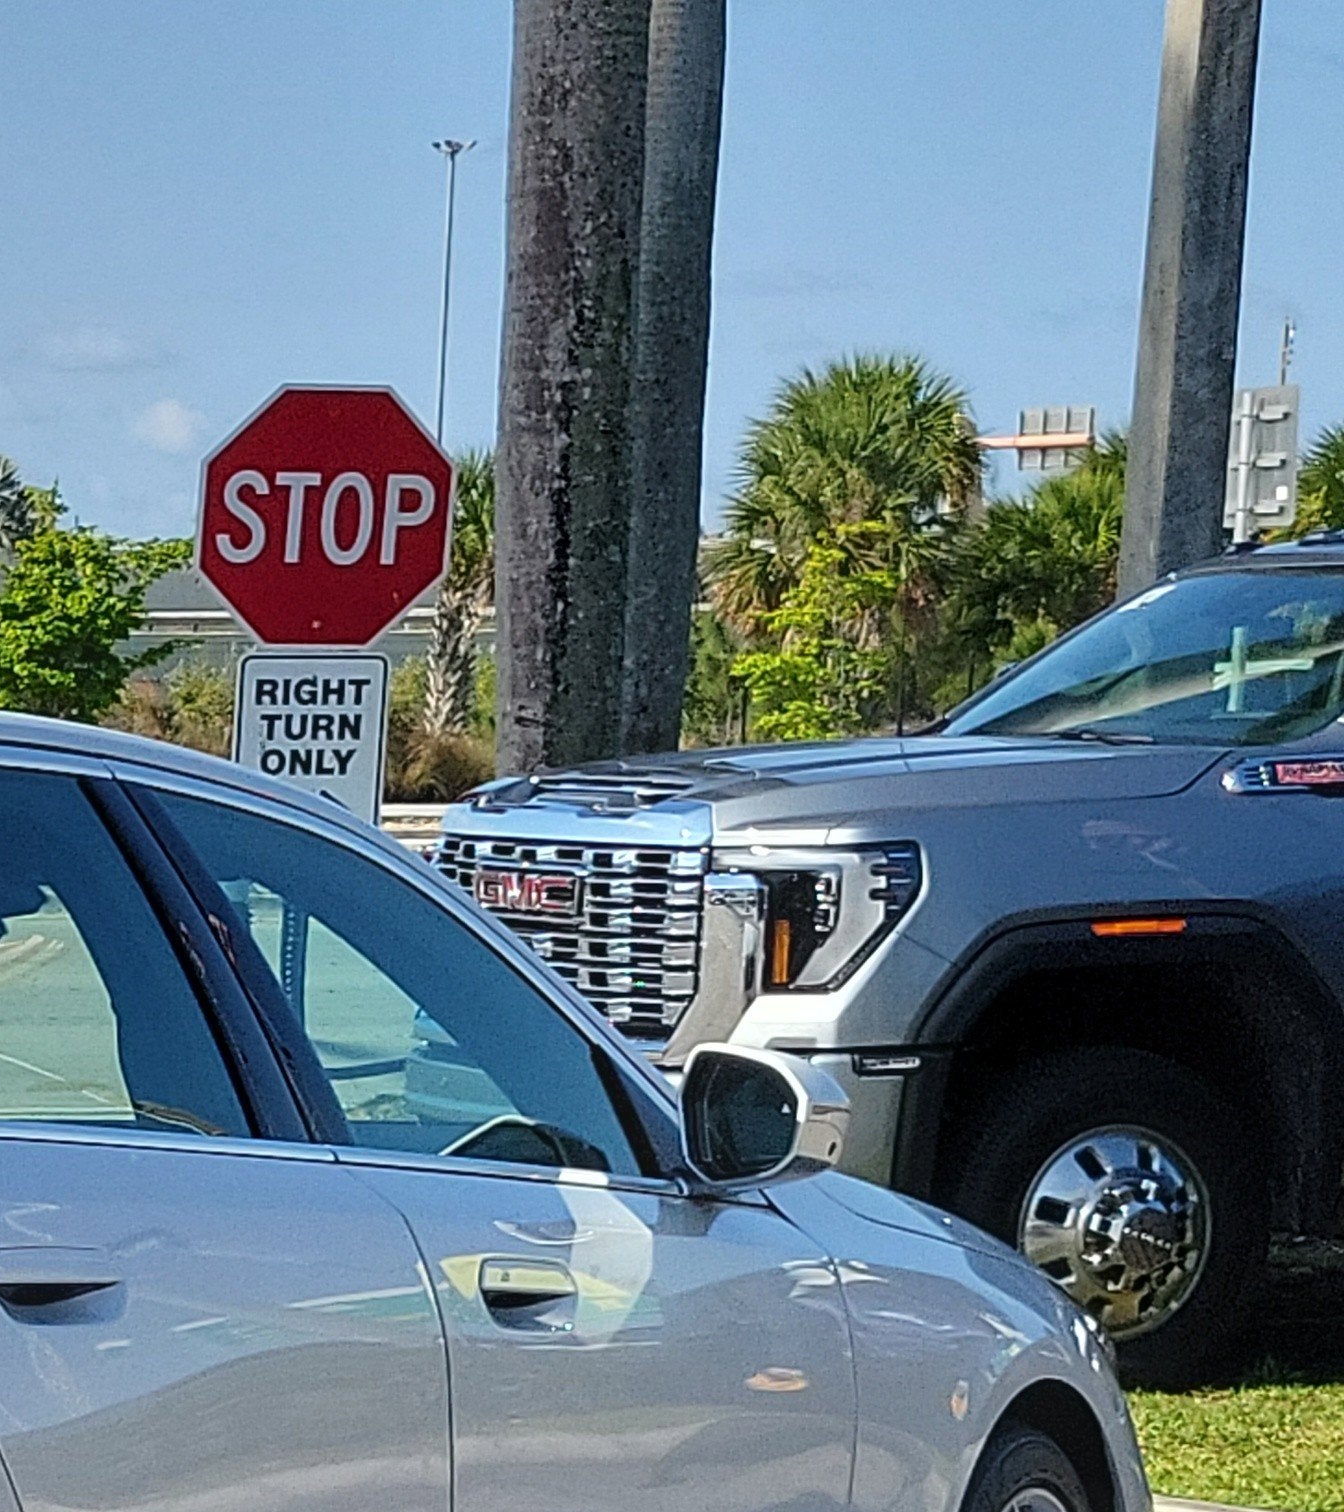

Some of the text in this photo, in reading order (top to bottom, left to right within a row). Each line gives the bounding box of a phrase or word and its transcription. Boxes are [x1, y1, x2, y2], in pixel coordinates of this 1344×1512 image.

[215, 469, 436, 566] STOP
[255, 678, 371, 706] RIGHT
[260, 714, 362, 741] TURN
[260, 748, 357, 776] ONLY
[474, 871, 576, 911] GMC
